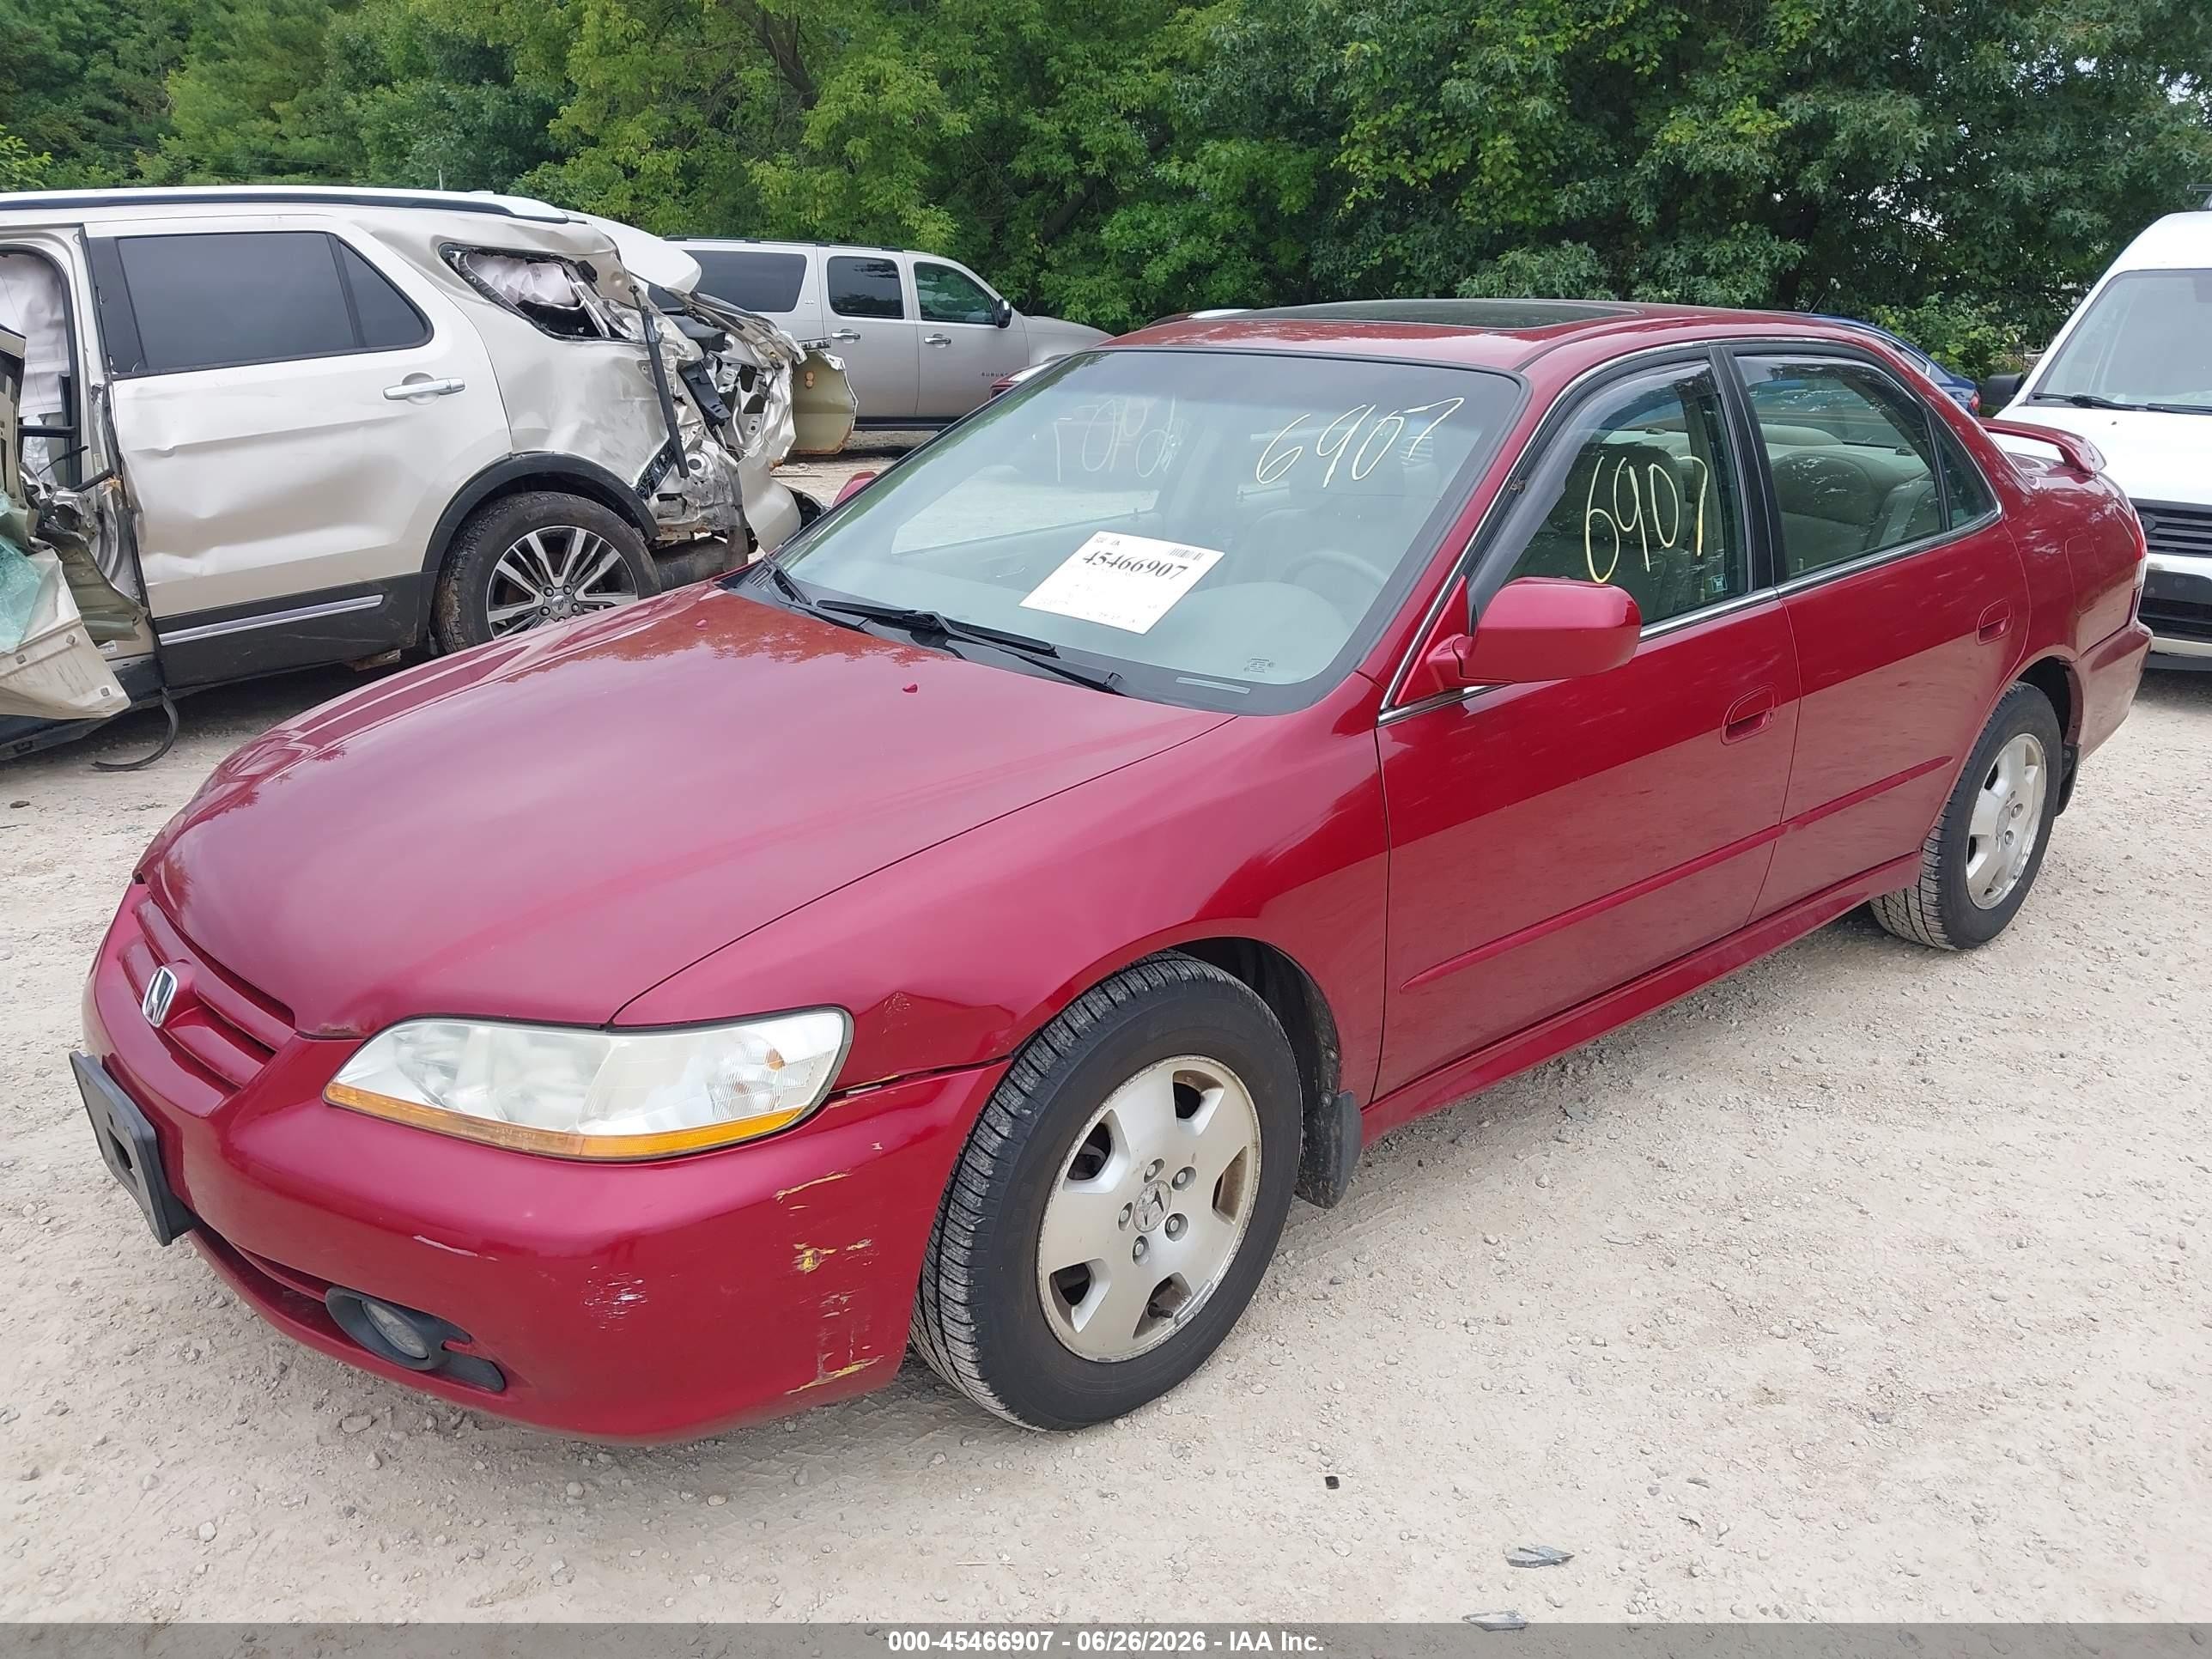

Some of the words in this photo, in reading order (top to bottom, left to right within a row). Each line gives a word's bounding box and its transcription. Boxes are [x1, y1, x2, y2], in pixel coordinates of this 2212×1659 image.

[1255, 397, 1465, 489] 6907
[1082, 550, 1189, 580] 45466907
[1585, 455, 1709, 583] 6907
